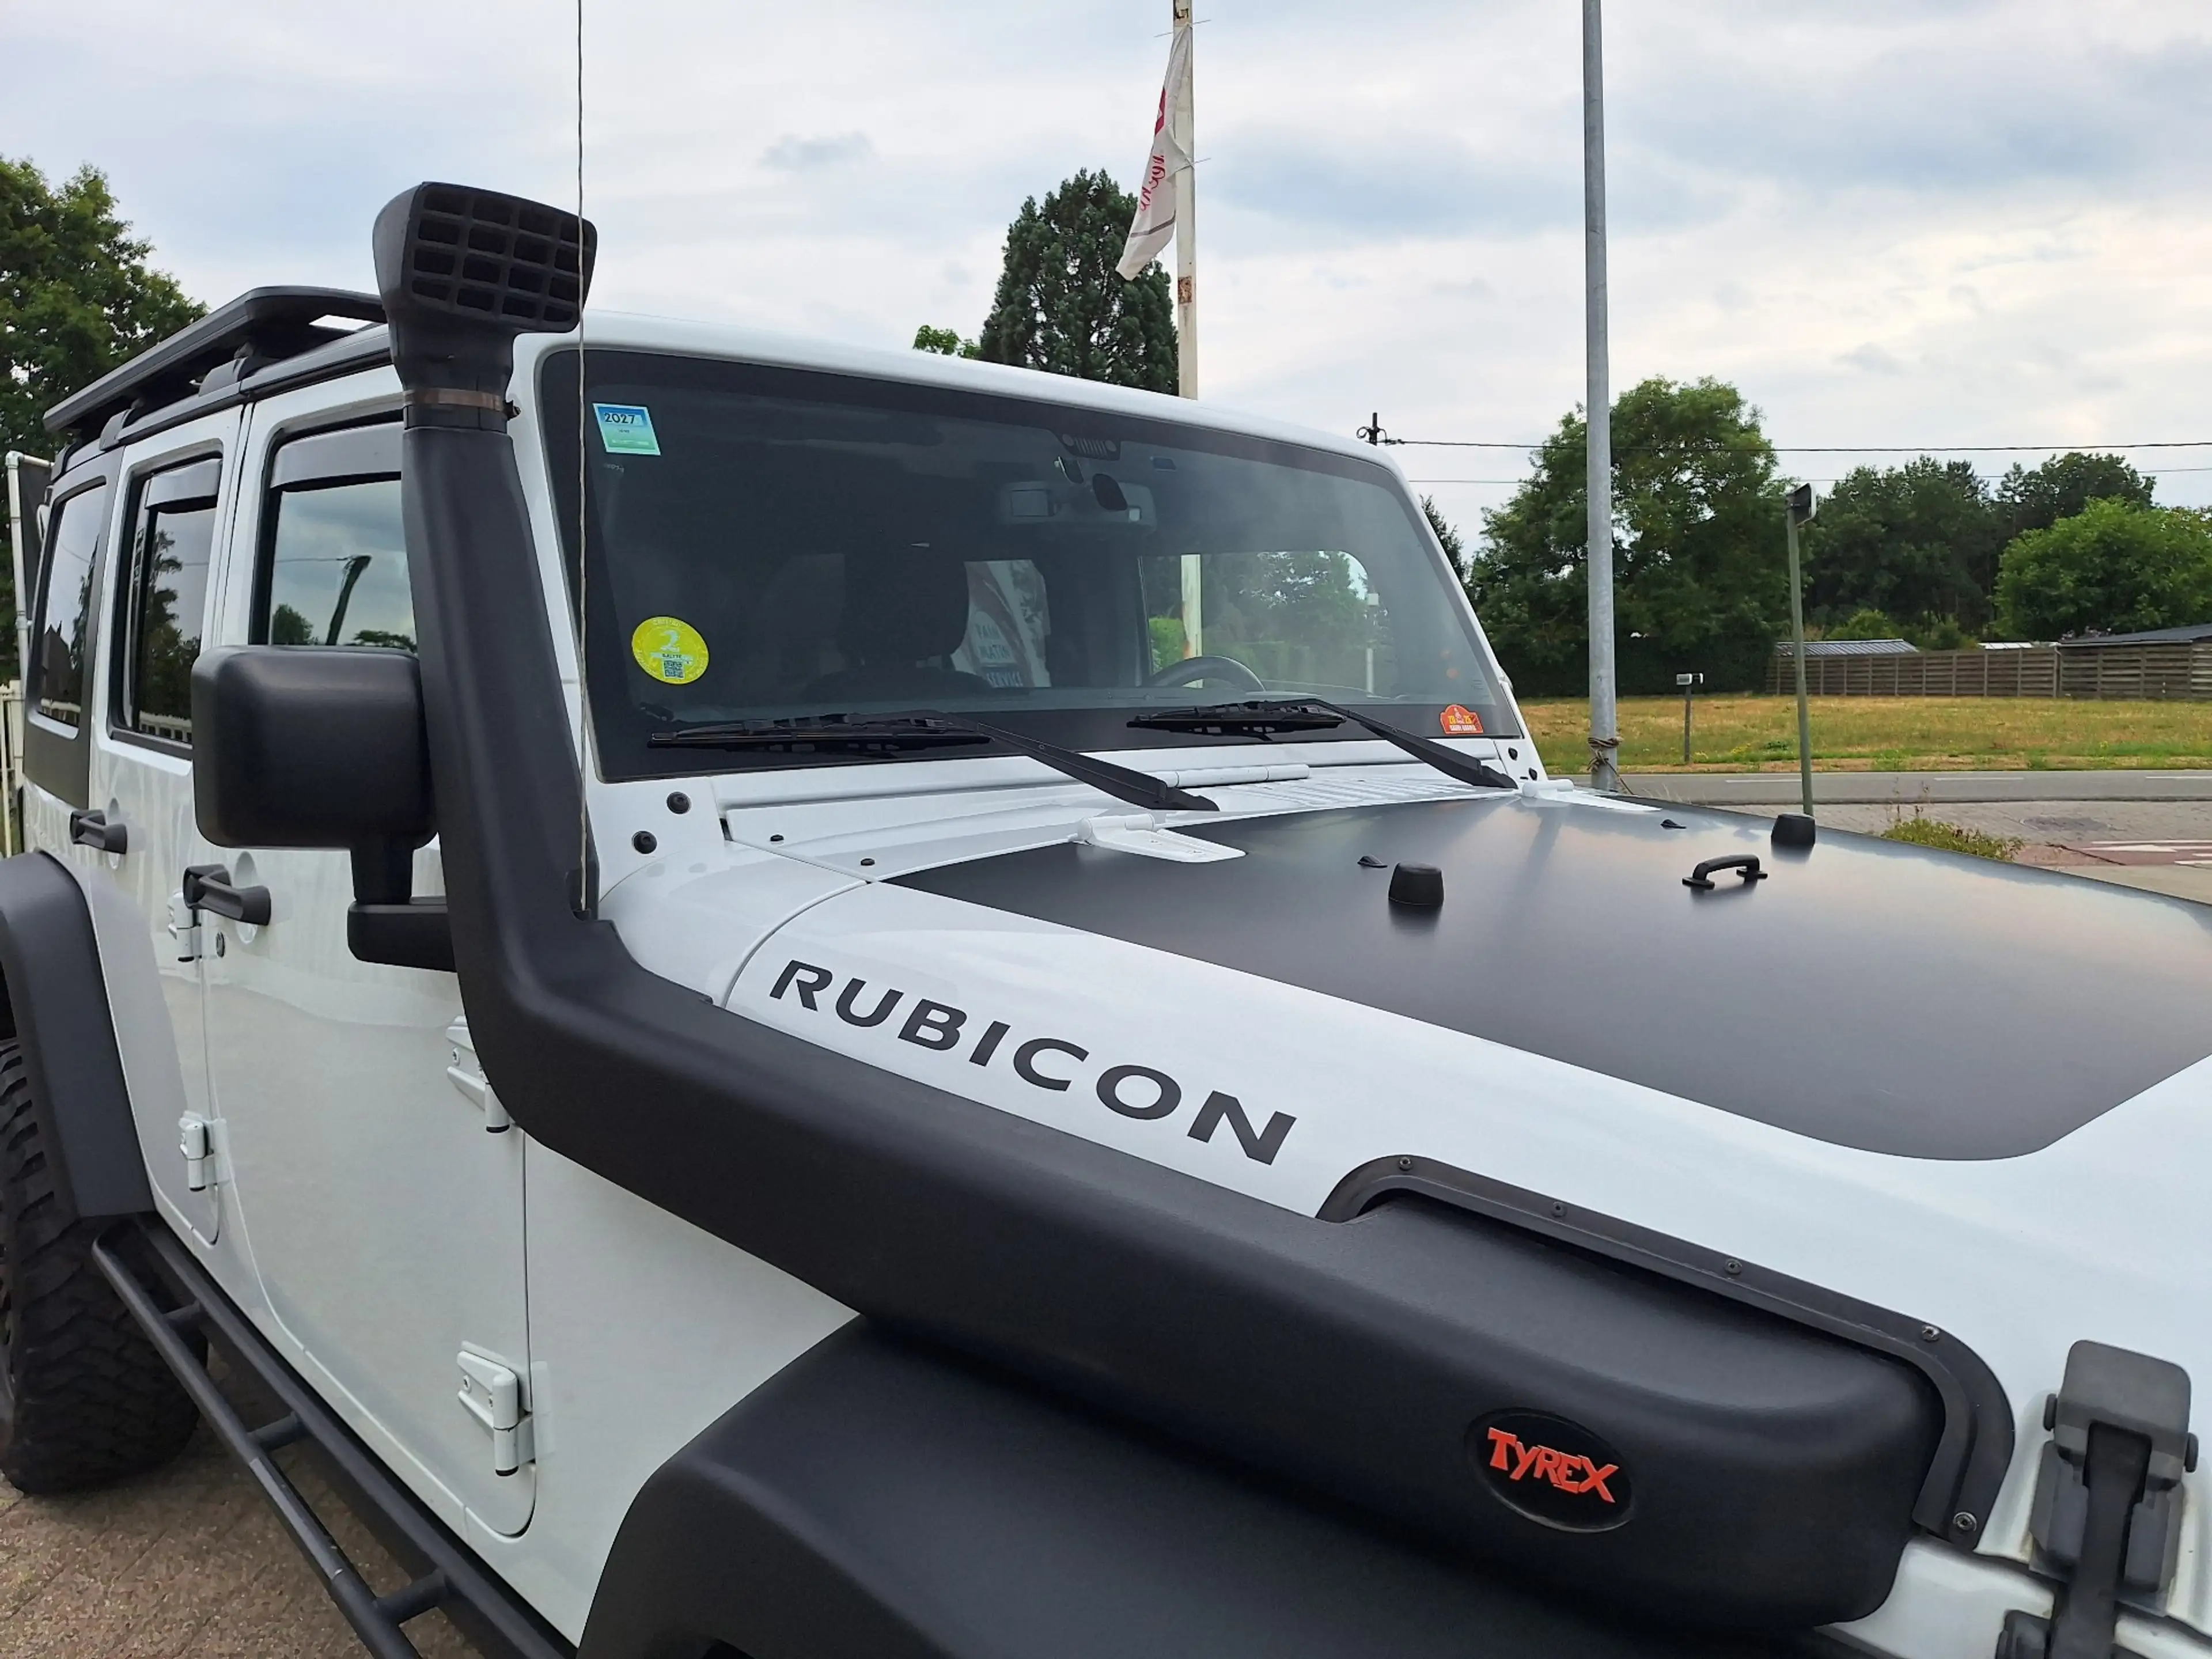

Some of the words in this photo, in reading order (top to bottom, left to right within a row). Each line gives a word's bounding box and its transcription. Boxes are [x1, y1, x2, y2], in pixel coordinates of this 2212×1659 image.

[604, 412, 635, 424] 2027
[660, 629, 680, 652] 2
[768, 959, 1297, 1166] RUBICON
[1487, 1426, 1620, 1503] TYREX
